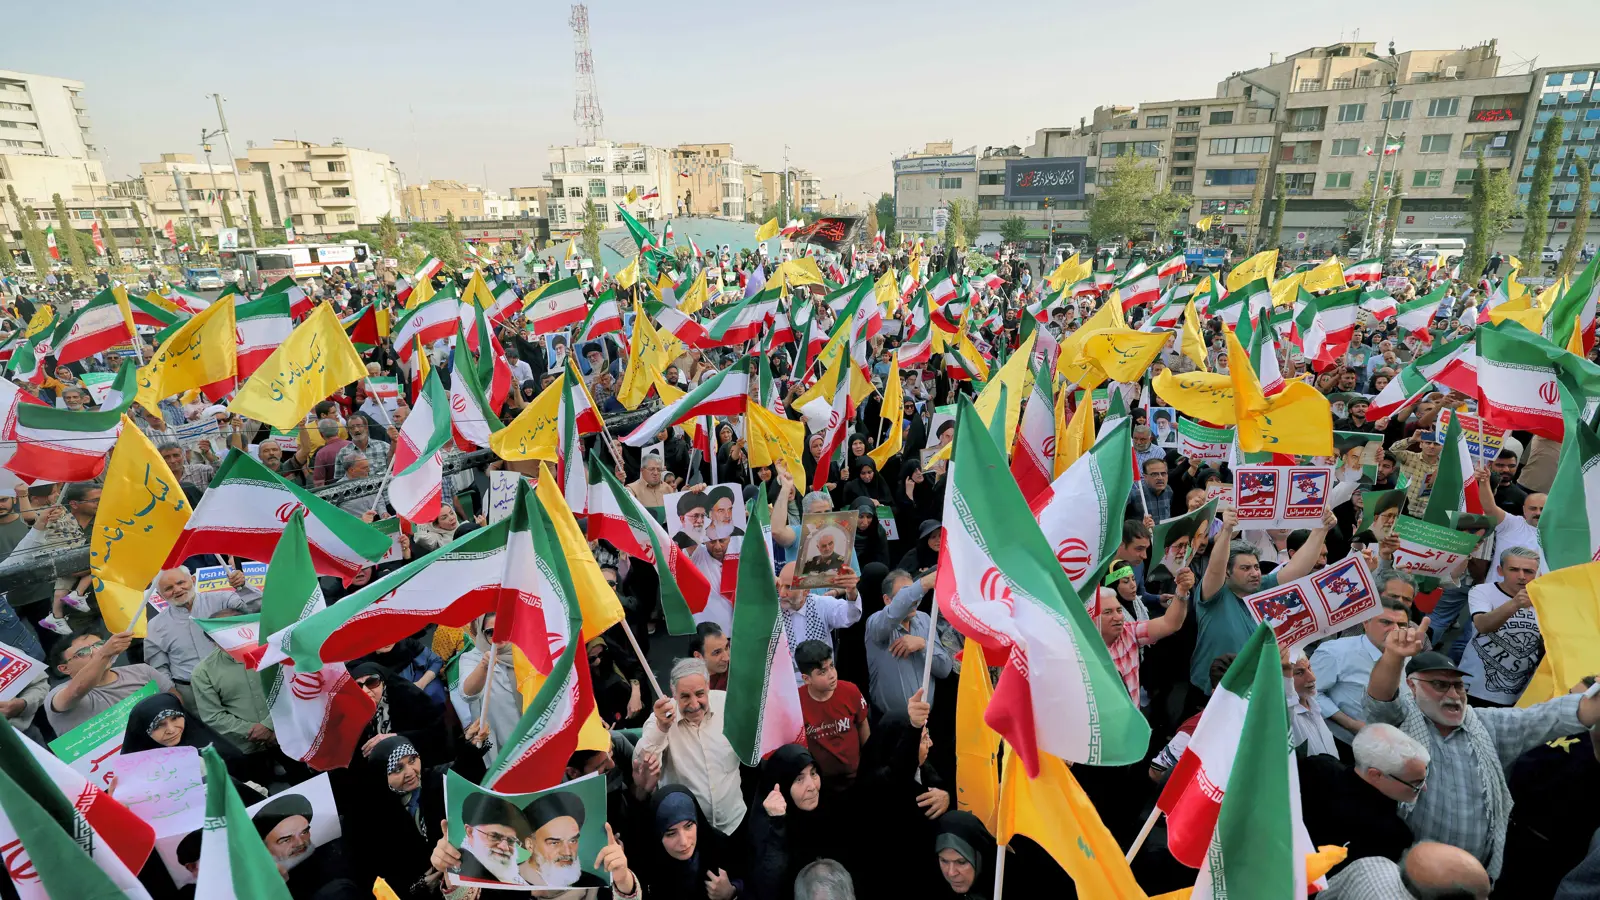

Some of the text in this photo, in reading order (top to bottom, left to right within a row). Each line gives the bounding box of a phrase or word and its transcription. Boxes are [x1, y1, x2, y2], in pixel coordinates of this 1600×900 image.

[176, 324, 204, 360] لبیک
[304, 334, 324, 374] لبیک
[1114, 345, 1145, 364] لبیک
[134, 463, 184, 516] لبیک
[492, 472, 514, 492] سازش
[91, 526, 124, 563] خامنه
[1447, 554, 1458, 564] تا
[148, 766, 177, 781] برای
[168, 778, 201, 802] خرید
[152, 802, 190, 819] است
